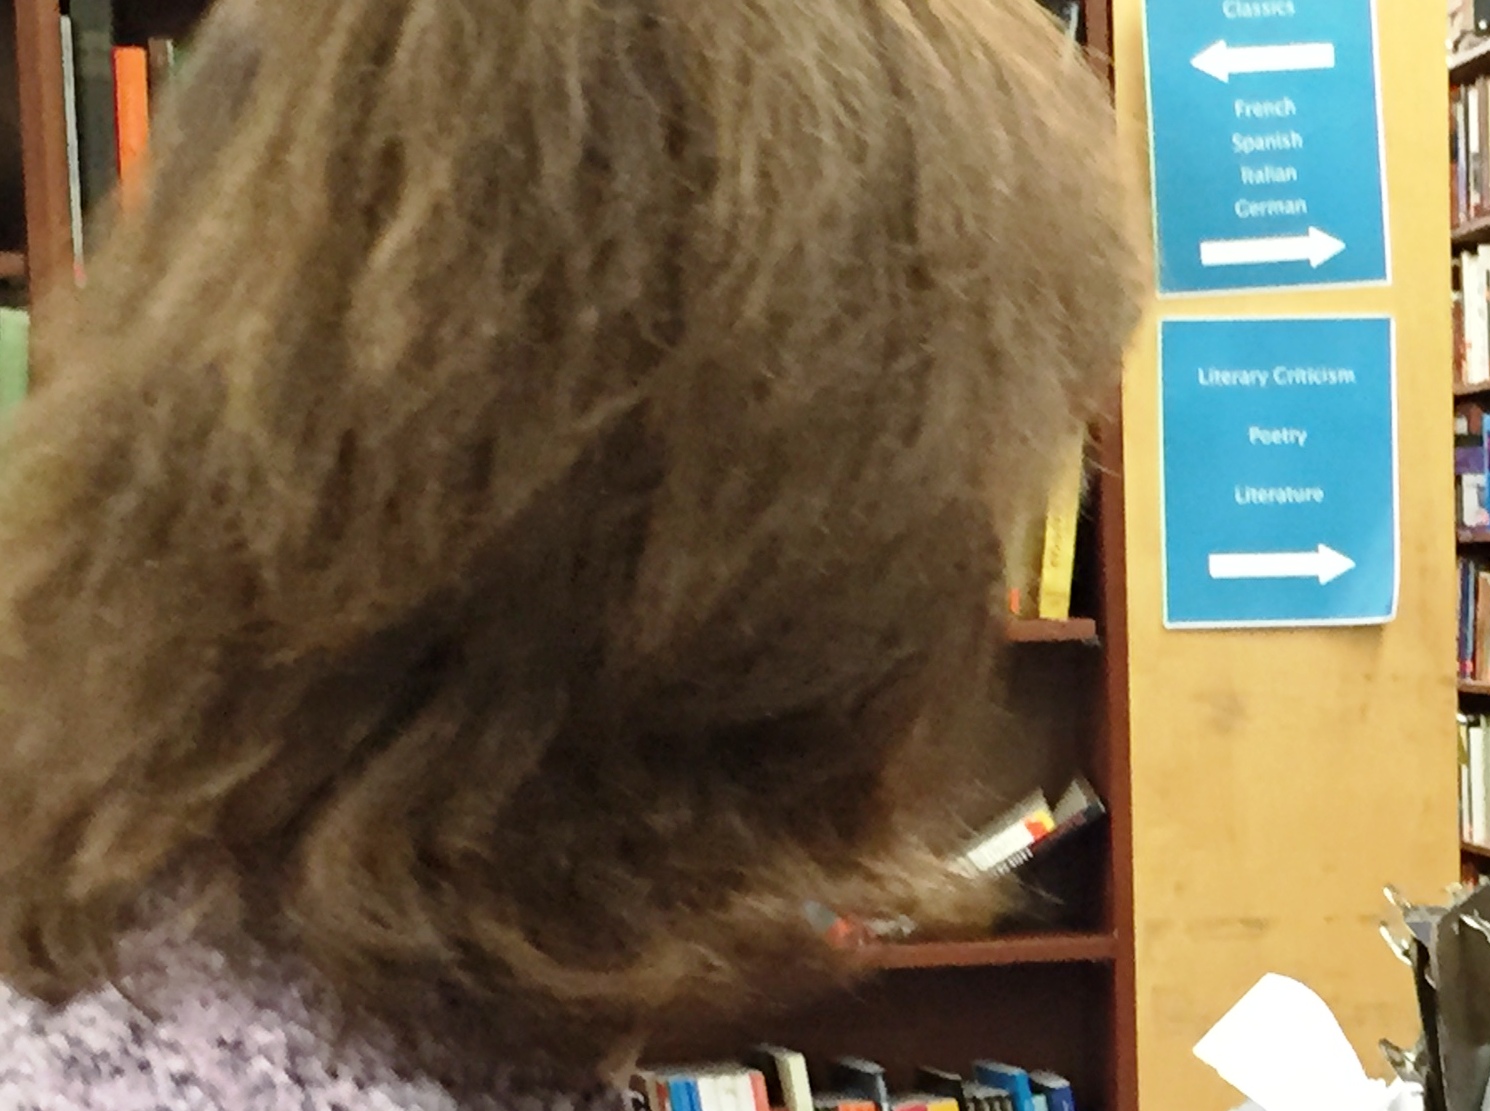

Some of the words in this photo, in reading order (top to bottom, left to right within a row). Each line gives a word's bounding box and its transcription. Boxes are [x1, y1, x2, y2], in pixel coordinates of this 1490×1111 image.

[1222, 0, 1296, 19] Classics
[1234, 97, 1296, 118] French
[1231, 131, 1303, 154] Spanish
[1240, 165, 1297, 185] Italian
[1234, 197, 1307, 218] German
[1198, 366, 1269, 388] Literary
[1272, 366, 1356, 385] Criticism
[1249, 426, 1308, 447] Poetry
[1234, 485, 1325, 505] Literature
